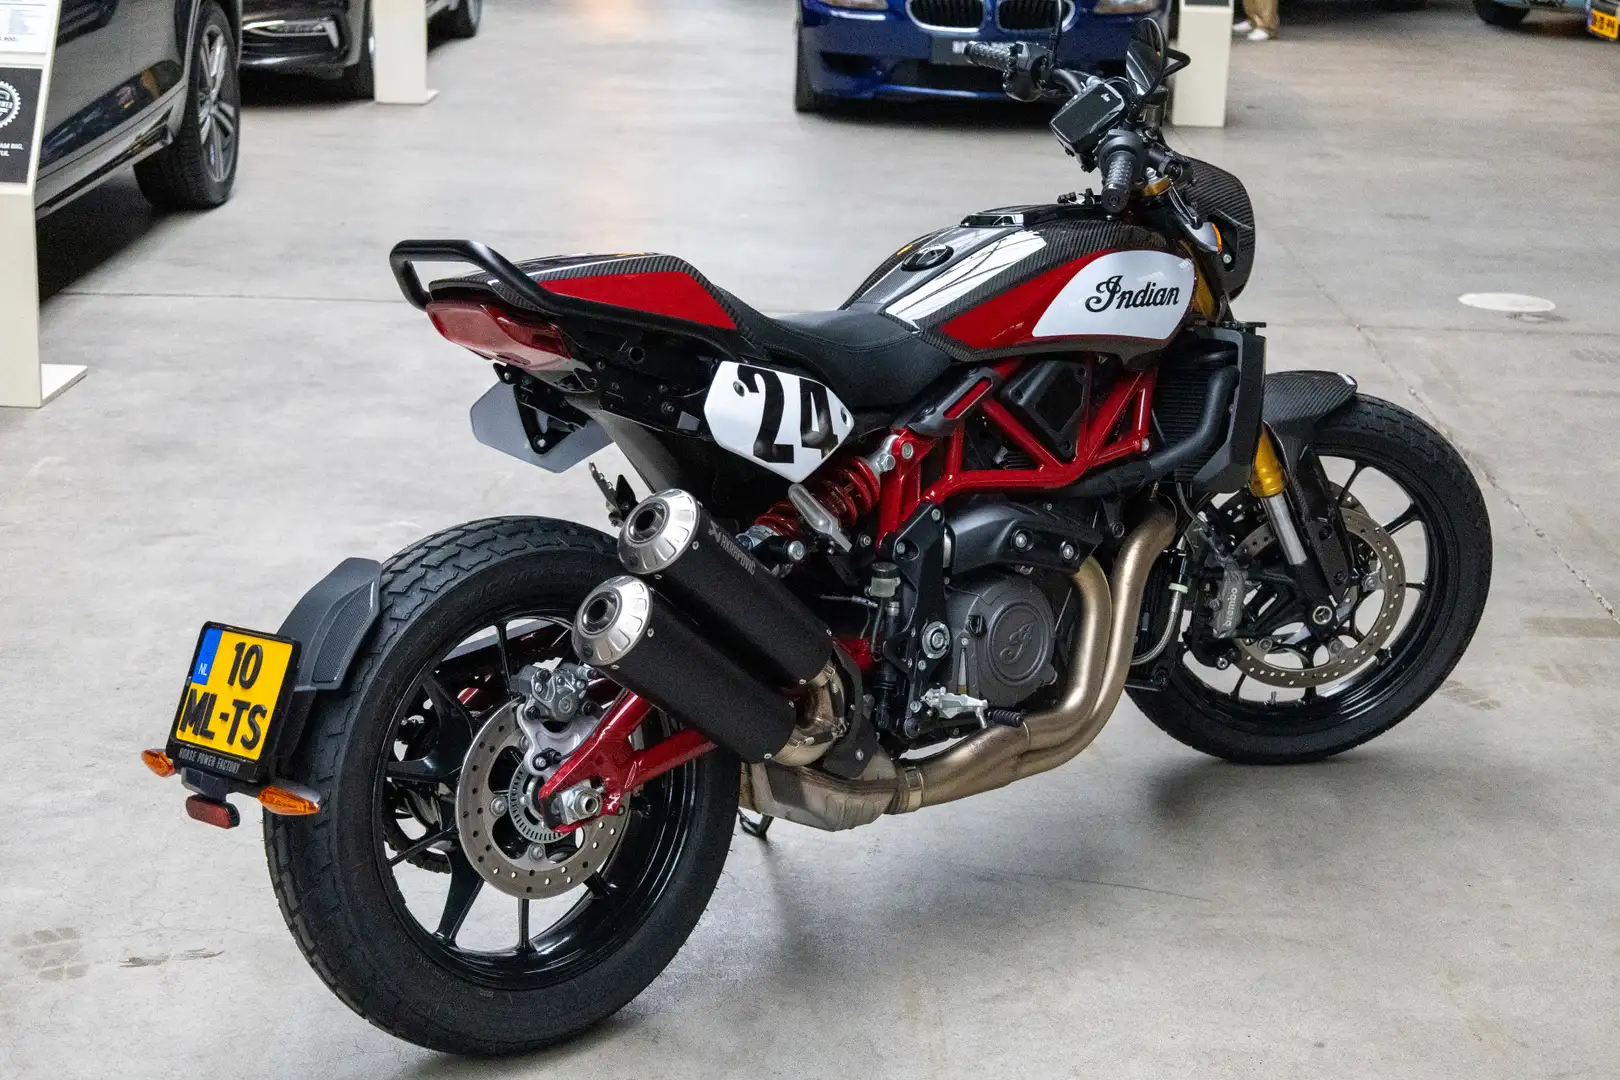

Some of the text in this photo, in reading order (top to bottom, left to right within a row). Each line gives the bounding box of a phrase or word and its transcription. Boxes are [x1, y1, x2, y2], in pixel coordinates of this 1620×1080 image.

[1085, 275, 1180, 312] Indian
[737, 364, 839, 464] 24
[1222, 587, 1238, 627] brembo
[198, 662, 208, 676] NL
[227, 642, 263, 690] 10
[179, 689, 267, 750] ML-TS
[178, 747, 240, 774] HORSE POWER FACTORY
